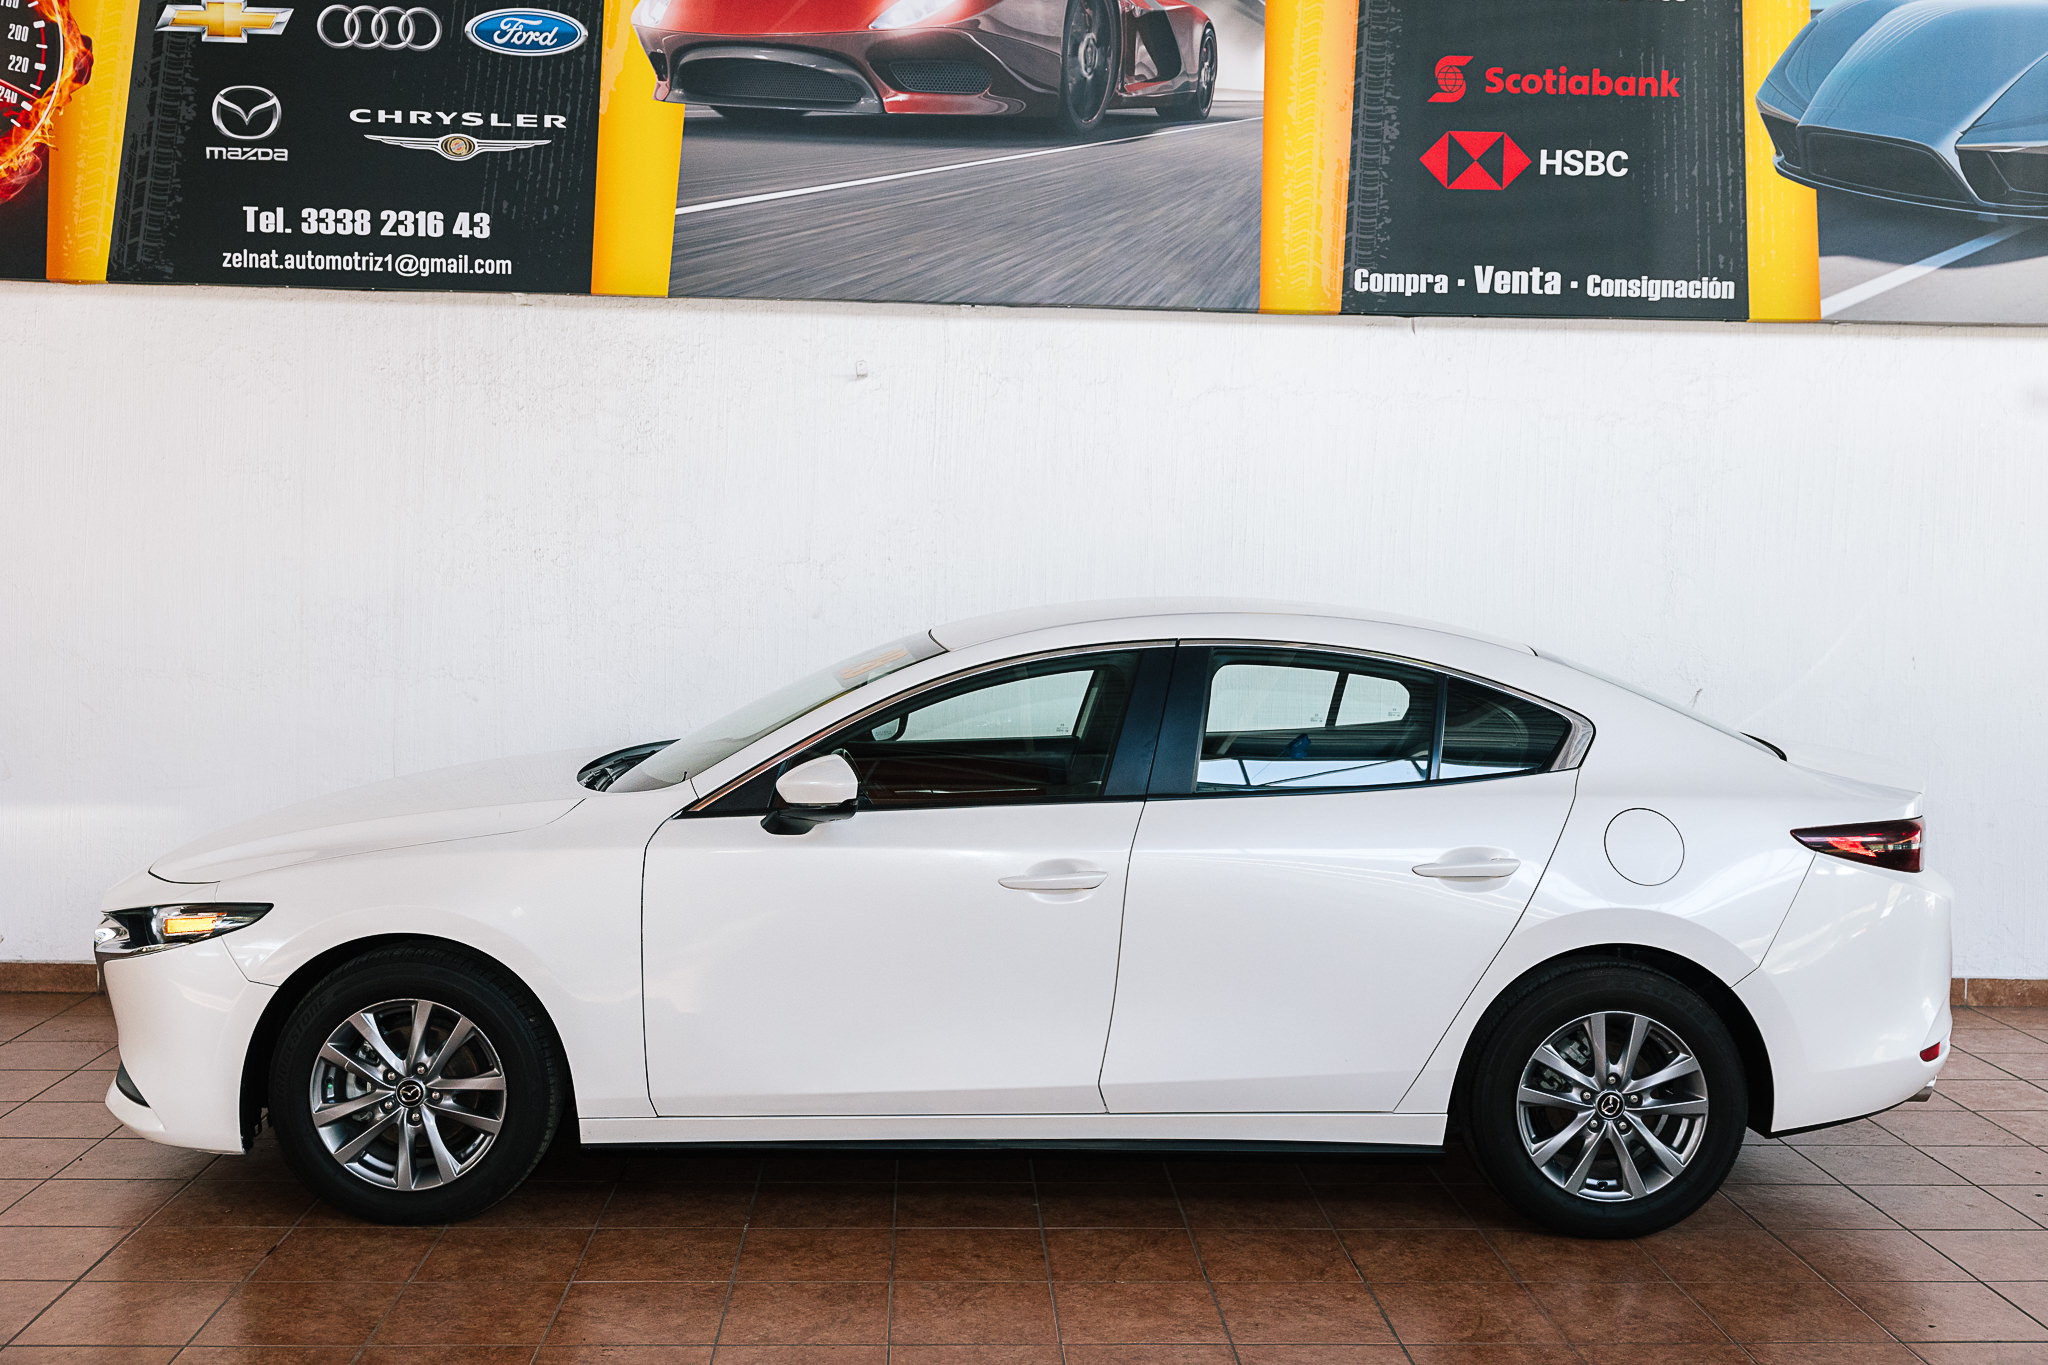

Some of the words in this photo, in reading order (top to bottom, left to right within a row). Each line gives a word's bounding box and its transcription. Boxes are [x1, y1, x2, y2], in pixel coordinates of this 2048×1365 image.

[7, 23, 29, 42] 200
[493, 17, 559, 46] Ford
[7, 54, 29, 73] 220
[1485, 66, 1681, 98] Scotiabank
[349, 109, 567, 129] CHRYSLER
[1539, 149, 1629, 177] HSBC
[242, 206, 293, 234] Tel.
[301, 207, 371, 236] 3338
[380, 210, 444, 237] 2316
[452, 211, 491, 239] 43
[222, 248, 512, 277] zelnat.automotriz1@gmail.com
[1354, 268, 1449, 297] Compra
[1473, 265, 1562, 295] Venta
[1586, 275, 1735, 301] Consignación
